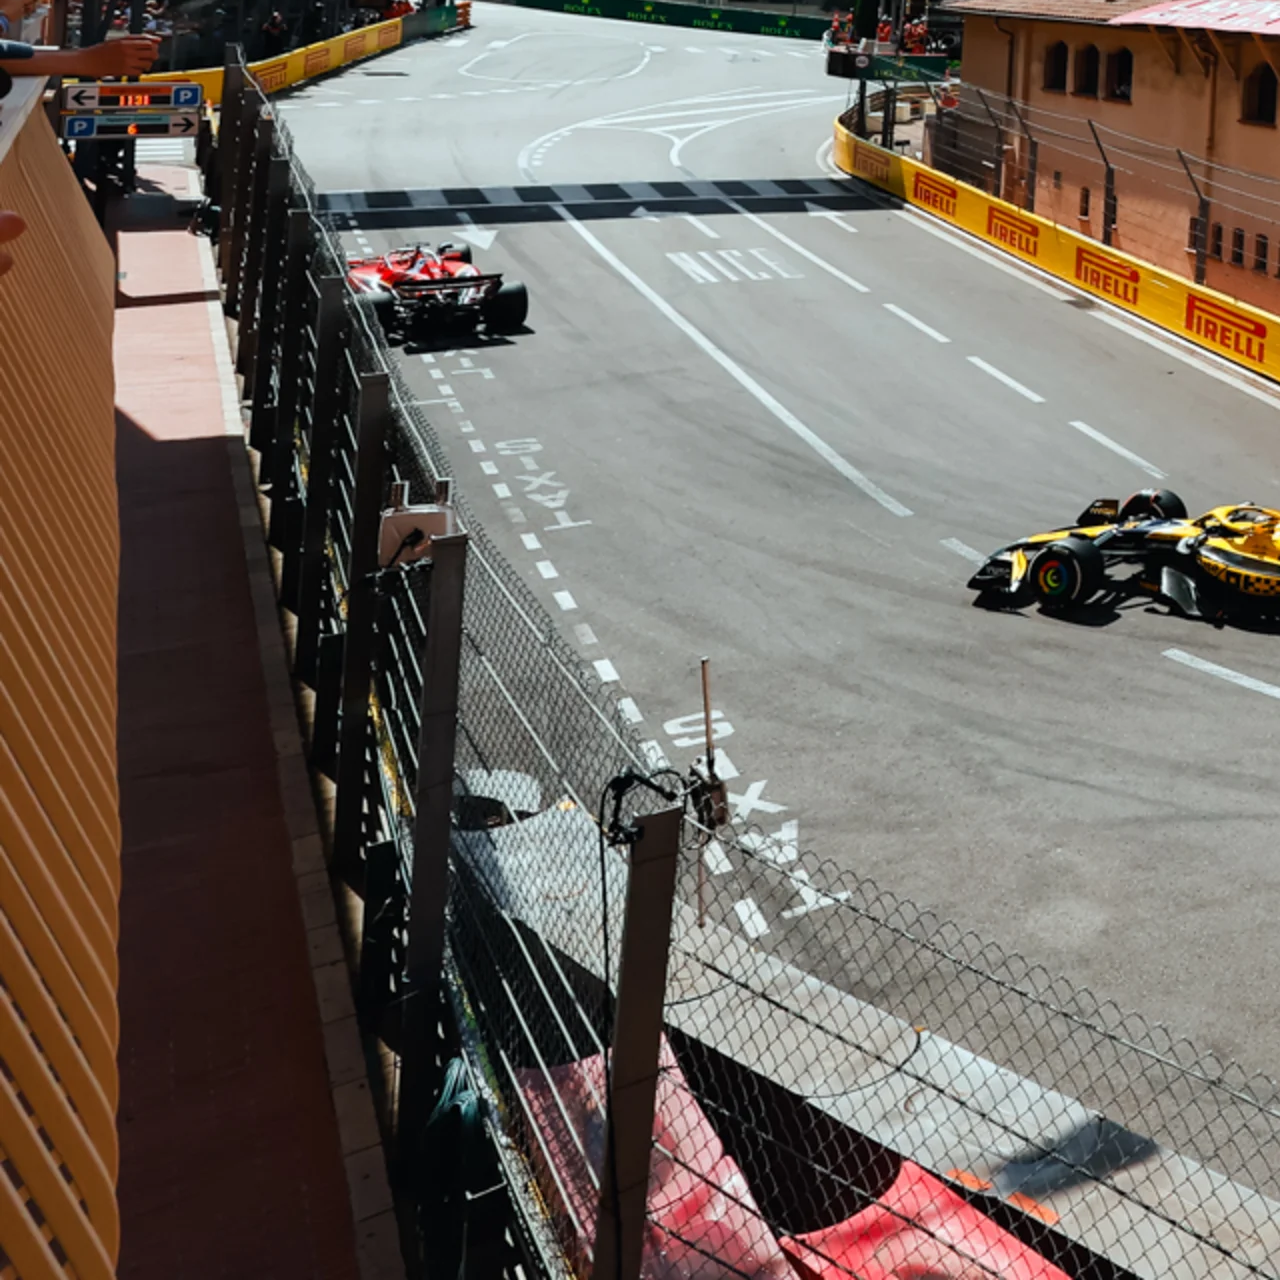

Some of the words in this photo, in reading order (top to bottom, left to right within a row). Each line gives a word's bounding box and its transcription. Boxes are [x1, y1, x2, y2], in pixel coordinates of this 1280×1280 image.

[563, 3, 602, 16] ROLEX
[626, 11, 667, 23] ROLEX
[692, 19, 733, 31] ROLEX
[760, 25, 801, 37] ROLEX
[179, 90, 193, 103] P
[73, 120, 88, 134] P
[853, 144, 892, 184] PIRELLI
[914, 171, 958, 219] PIRELLI
[986, 206, 1040, 257] PIRELLI
[665, 248, 805, 284] NICE
[1075, 246, 1141, 306] PIRELLI
[1185, 292, 1267, 364] PIRELLI
[494, 437, 592, 530] TAXIS
[663, 709, 852, 924] TAXIS
